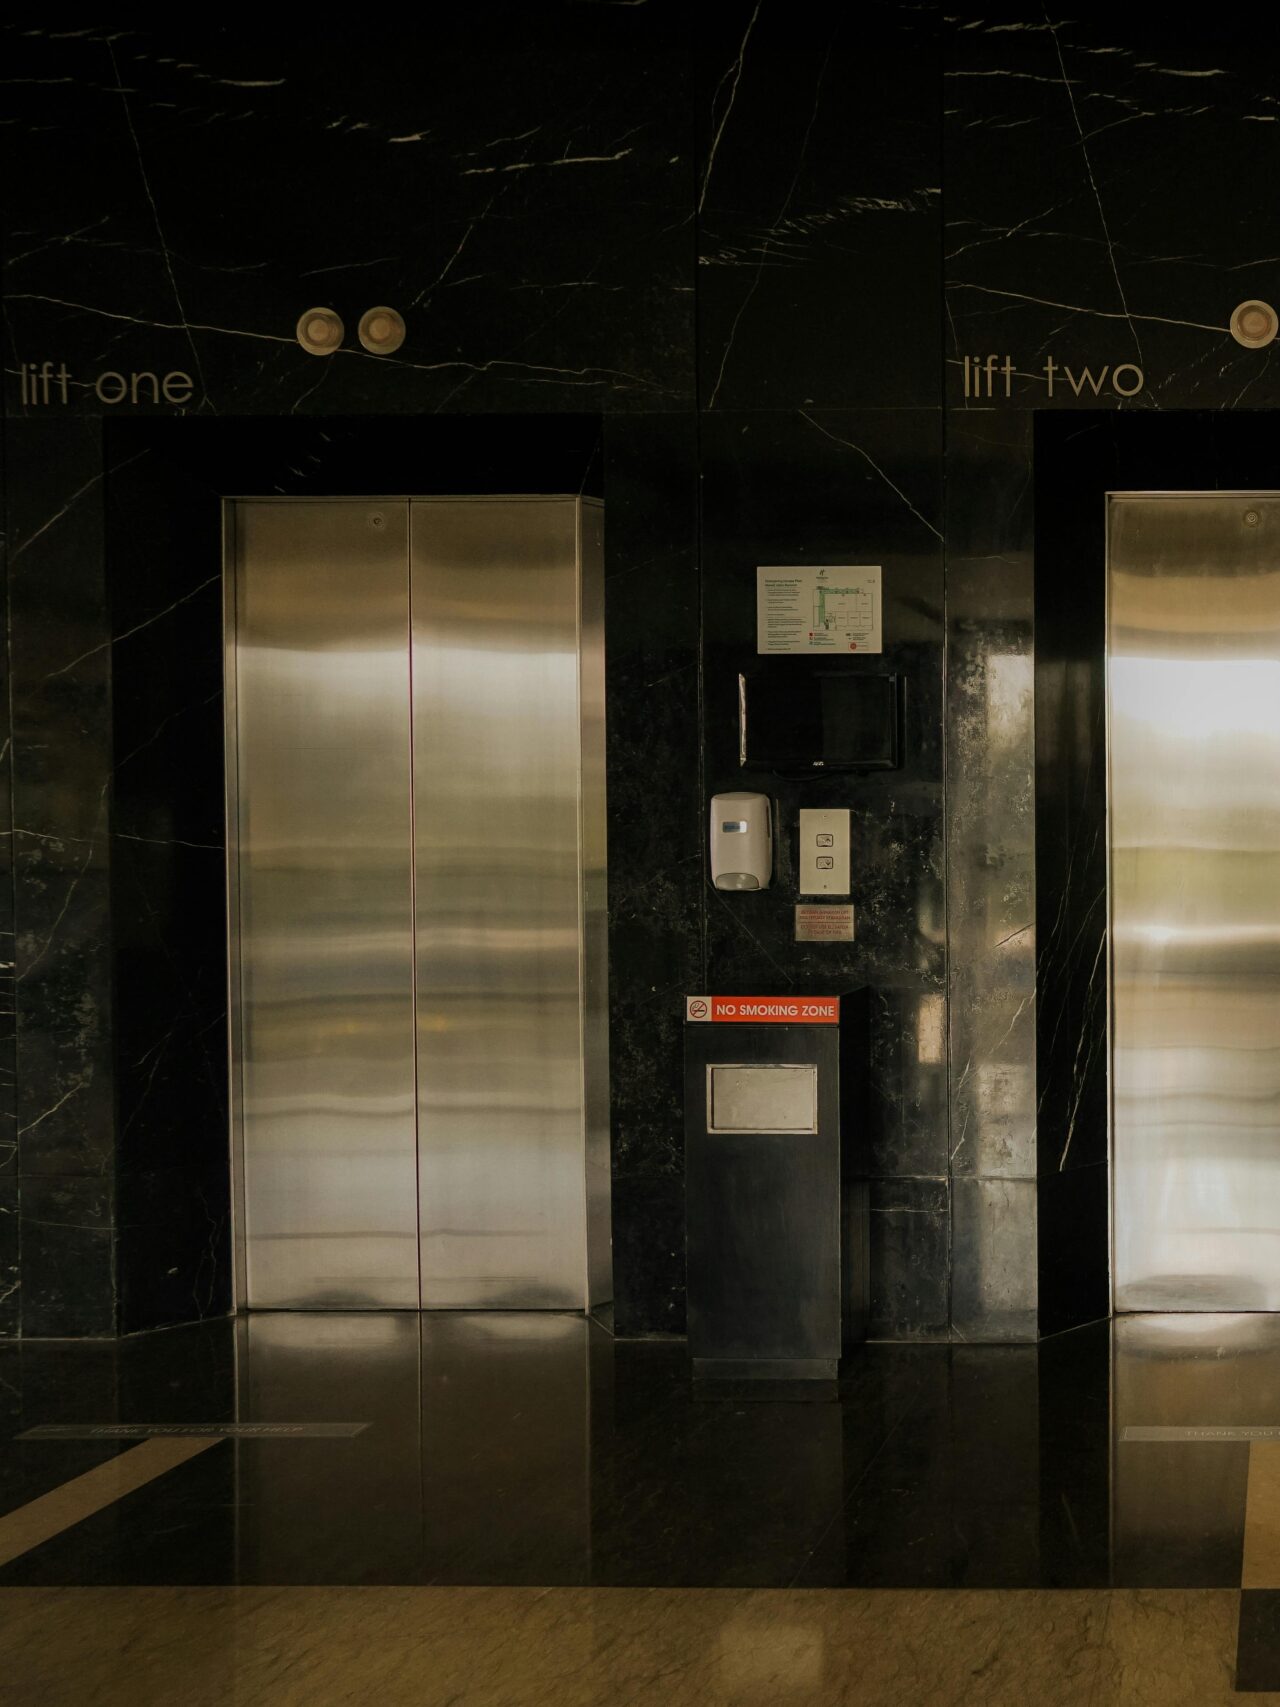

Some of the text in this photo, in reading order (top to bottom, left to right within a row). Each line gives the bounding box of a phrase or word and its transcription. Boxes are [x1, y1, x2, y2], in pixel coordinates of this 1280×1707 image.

[22, 361, 194, 405] lift one
[963, 354, 1144, 397] lift two
[716, 1004, 835, 1017] NO SMOKING ZONE
